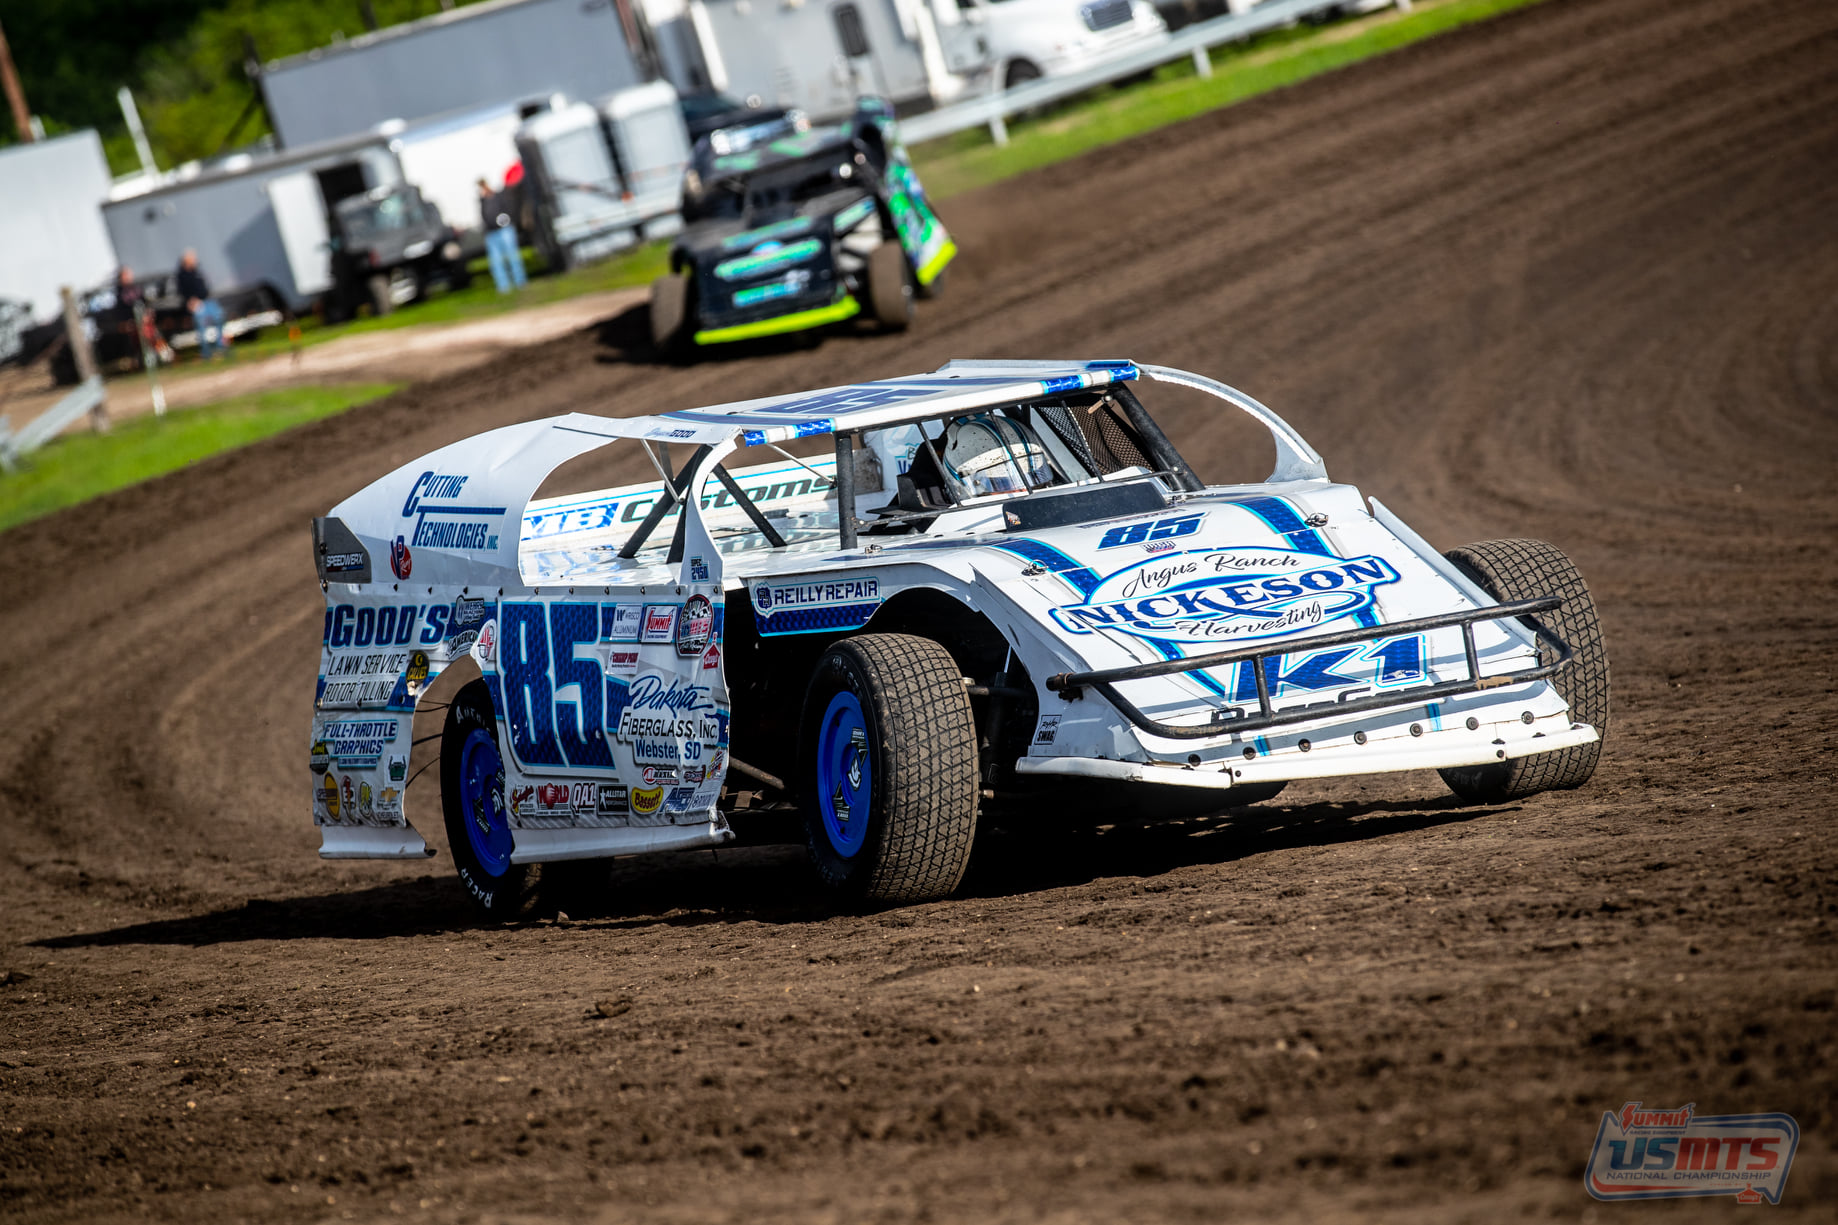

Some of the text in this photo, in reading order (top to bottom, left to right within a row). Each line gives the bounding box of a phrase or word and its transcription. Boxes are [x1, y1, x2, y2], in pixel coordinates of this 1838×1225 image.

[1097, 512, 1206, 550] 85
[326, 553, 363, 567] SPEEDWERX
[1122, 553, 1301, 598] Angus Ranch
[774, 580, 878, 605] REILLY REPAIR
[1066, 558, 1386, 630] NICKESON
[331, 604, 451, 648] GOOD'S
[1175, 600, 1323, 636] Harvesting
[328, 654, 408, 676] LAWN SERVICE
[1235, 634, 1423, 702] K1
[323, 681, 396, 702] ROTOR TILLING
[500, 601, 616, 769] 85
[632, 675, 714, 719] Dakota
[324, 722, 398, 739] FULL-THROTTLE
[334, 740, 385, 755] GRAPHICS
[635, 738, 701, 764] Webster, SD
[573, 783, 596, 811] QA1
